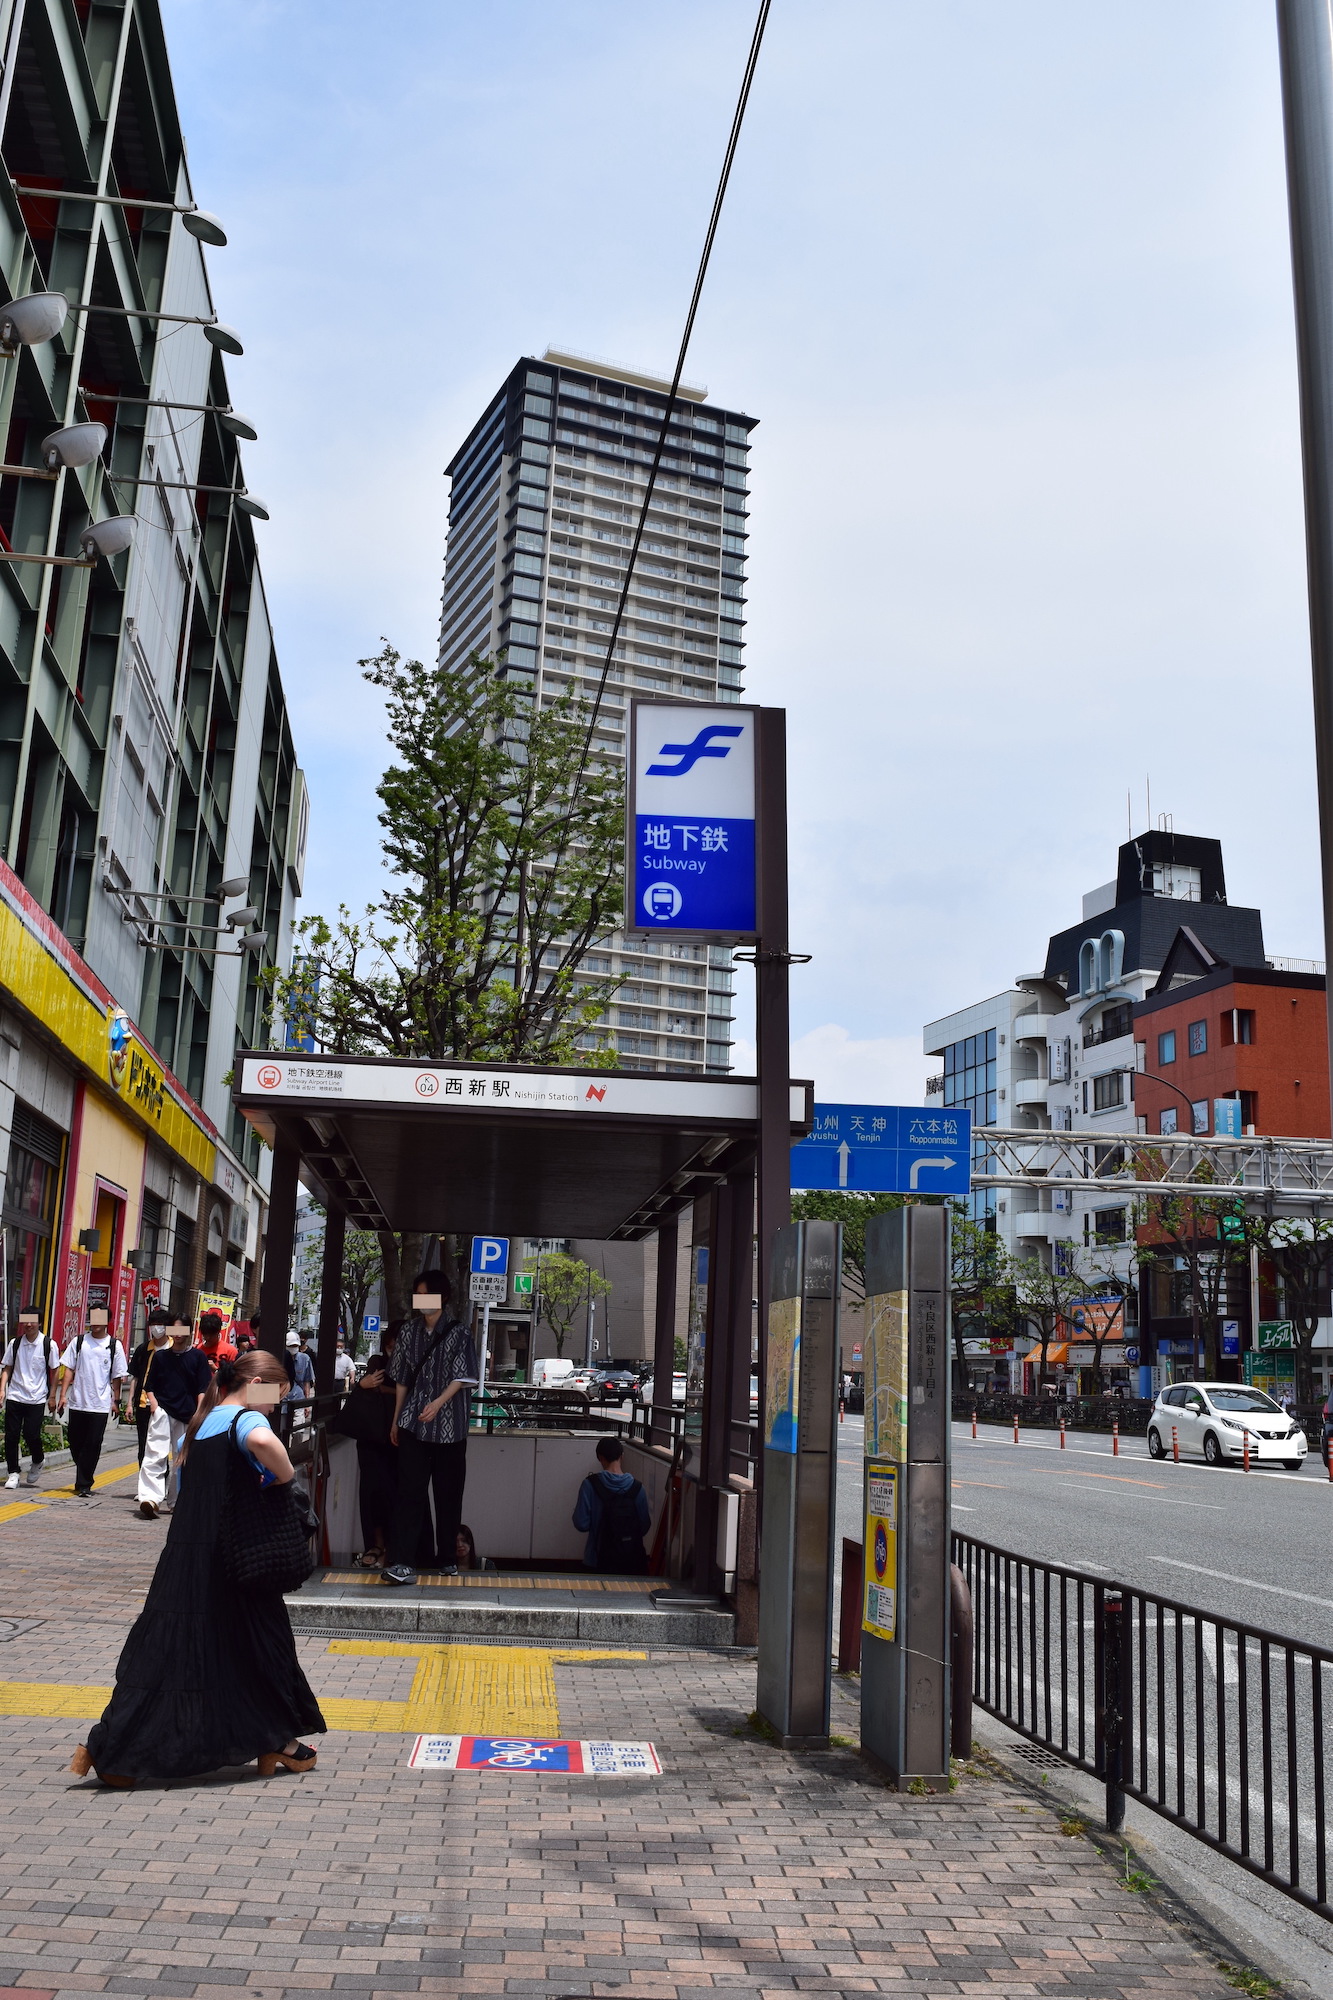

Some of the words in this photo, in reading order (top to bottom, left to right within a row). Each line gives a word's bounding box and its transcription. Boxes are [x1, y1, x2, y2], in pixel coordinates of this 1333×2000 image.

[643, 823, 729, 853] 地下鉄
[643, 855, 707, 875] Subway
[287, 1067, 343, 1079] 地下鉄空港線
[286, 1077, 308, 1085] Subway
[308, 1078, 328, 1086] Airport
[424, 1076, 430, 1084] K
[420, 1084, 434, 1093] 04
[444, 1077, 511, 1098] 西新駅
[514, 1090, 546, 1102] Nishijin
[548, 1092, 579, 1102] Station
[849, 1115, 887, 1133] 天神
[909, 1118, 958, 1135] 六本松
[856, 1132, 881, 1143] Tenjin
[909, 1134, 958, 1145] Ropponmatsu
[480, 1241, 502, 1270] P
[473, 1292, 503, 1300] ここから
[367, 1316, 377, 1330] P
[1260, 1323, 1290, 1348] エイブル
